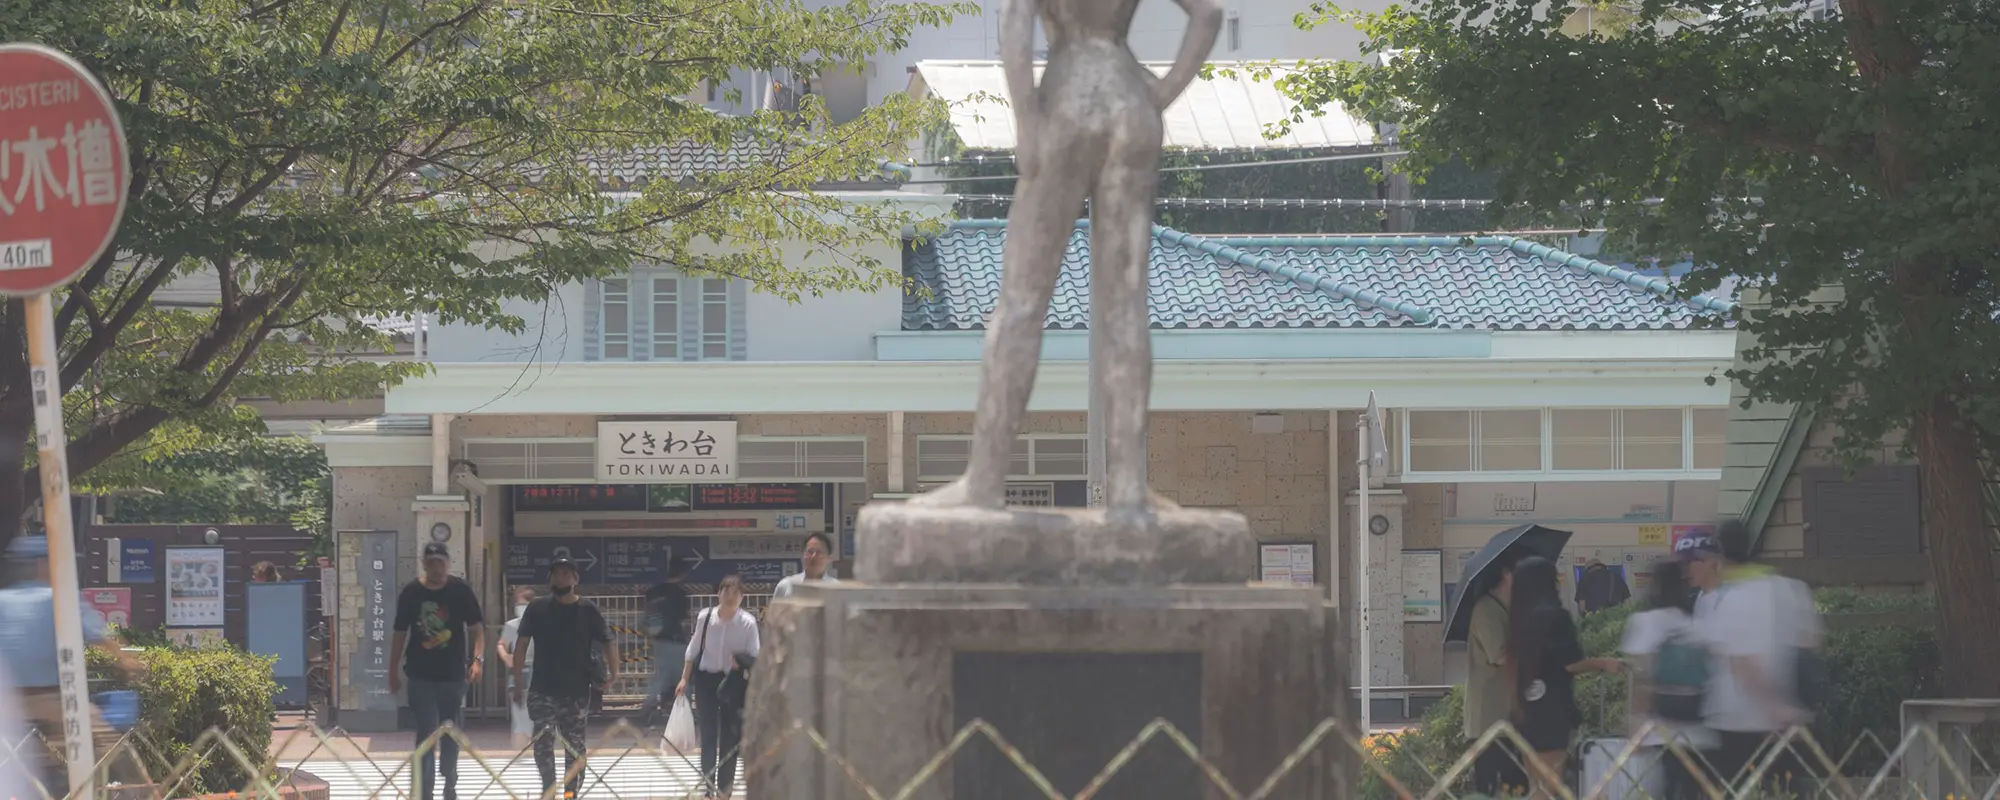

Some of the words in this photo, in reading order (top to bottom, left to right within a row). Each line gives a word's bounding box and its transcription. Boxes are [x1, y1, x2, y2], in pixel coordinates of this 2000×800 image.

[0, 80, 80, 111] CISTERN
[618, 430, 717, 456] ときわ台
[606, 464, 730, 475] TOKIWADAI
[776, 515, 807, 530] 北口
[372, 579, 384, 641] ときわ台駅
